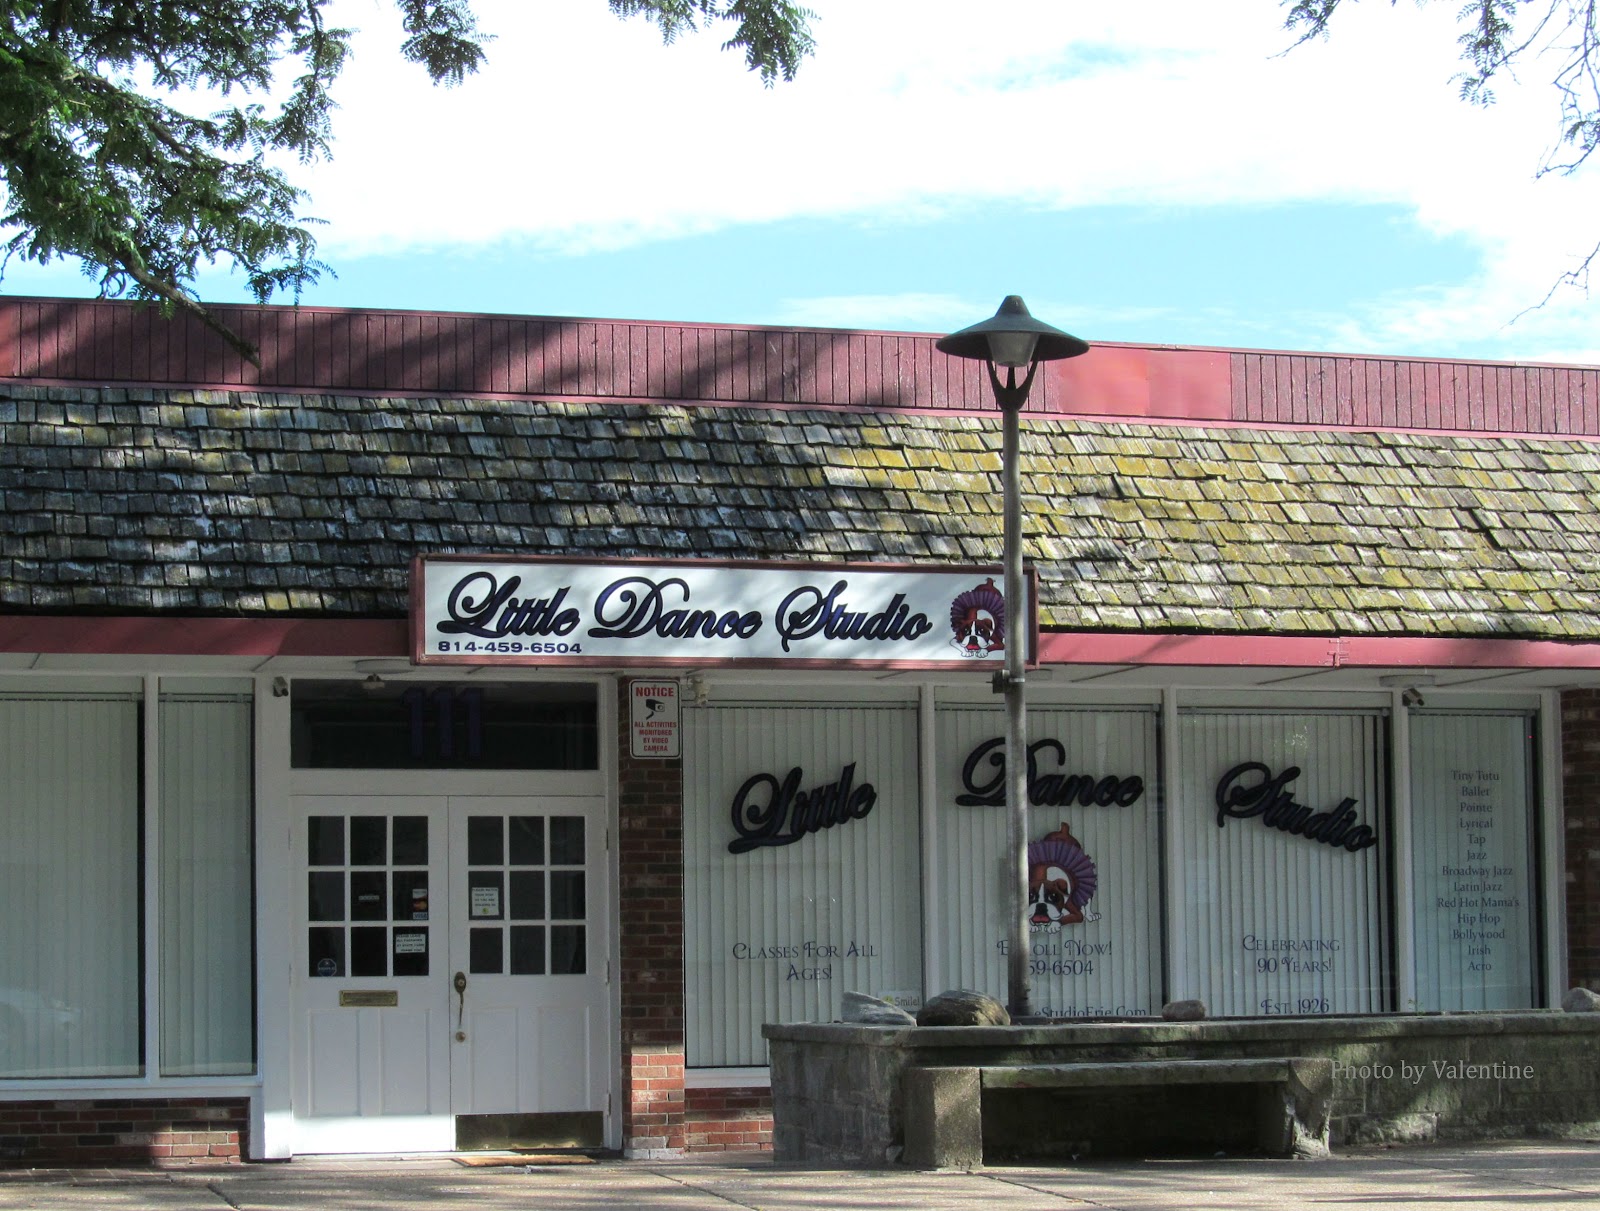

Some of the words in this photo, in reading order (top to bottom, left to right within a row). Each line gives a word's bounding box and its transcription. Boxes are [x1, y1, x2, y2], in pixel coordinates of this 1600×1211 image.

[437, 571, 580, 638] Little
[588, 576, 762, 638] Dance
[775, 580, 933, 652] Studio
[438, 641, 582, 653] 814-459-6504
[636, 687, 674, 697] NOTICE
[400, 687, 484, 760] 111
[955, 737, 1144, 807] Dance
[1451, 770, 1474, 783] Tiny
[1476, 770, 1500, 780] Tutu
[1462, 786, 1490, 796] Ballet
[728, 762, 877, 854] Little
[1216, 761, 1378, 852] Studio
[1460, 802, 1492, 812] Pointe
[1460, 818, 1493, 830] Lyrical
[1467, 834, 1486, 846] Tap
[1467, 850, 1487, 861] Jazz
[1442, 865, 1490, 878] Broadway
[1493, 866, 1513, 877] Jazz
[1454, 882, 1480, 892] Latin
[1483, 882, 1502, 893] Jazz
[1437, 897, 1456, 907] Red
[1460, 897, 1479, 907] Hot
[1481, 897, 1519, 907] Mama's
[1457, 913, 1476, 925] Hip
[1480, 913, 1500, 925] Hop
[1453, 929, 1505, 941] Bollywood
[997, 940, 1061, 956] EOLL
[1242, 935, 1340, 951] CELEBRATING
[732, 943, 799, 959] CLASSES
[804, 941, 840, 958] FOR
[847, 941, 878, 957] ALL
[1468, 945, 1491, 955] Irish
[1029, 960, 1094, 975] 59-6504
[1257, 957, 1278, 973] 90
[1468, 961, 1492, 971] Acro
[895, 996, 920, 1006] Smile!
[1298, 998, 1330, 1014] 1926
